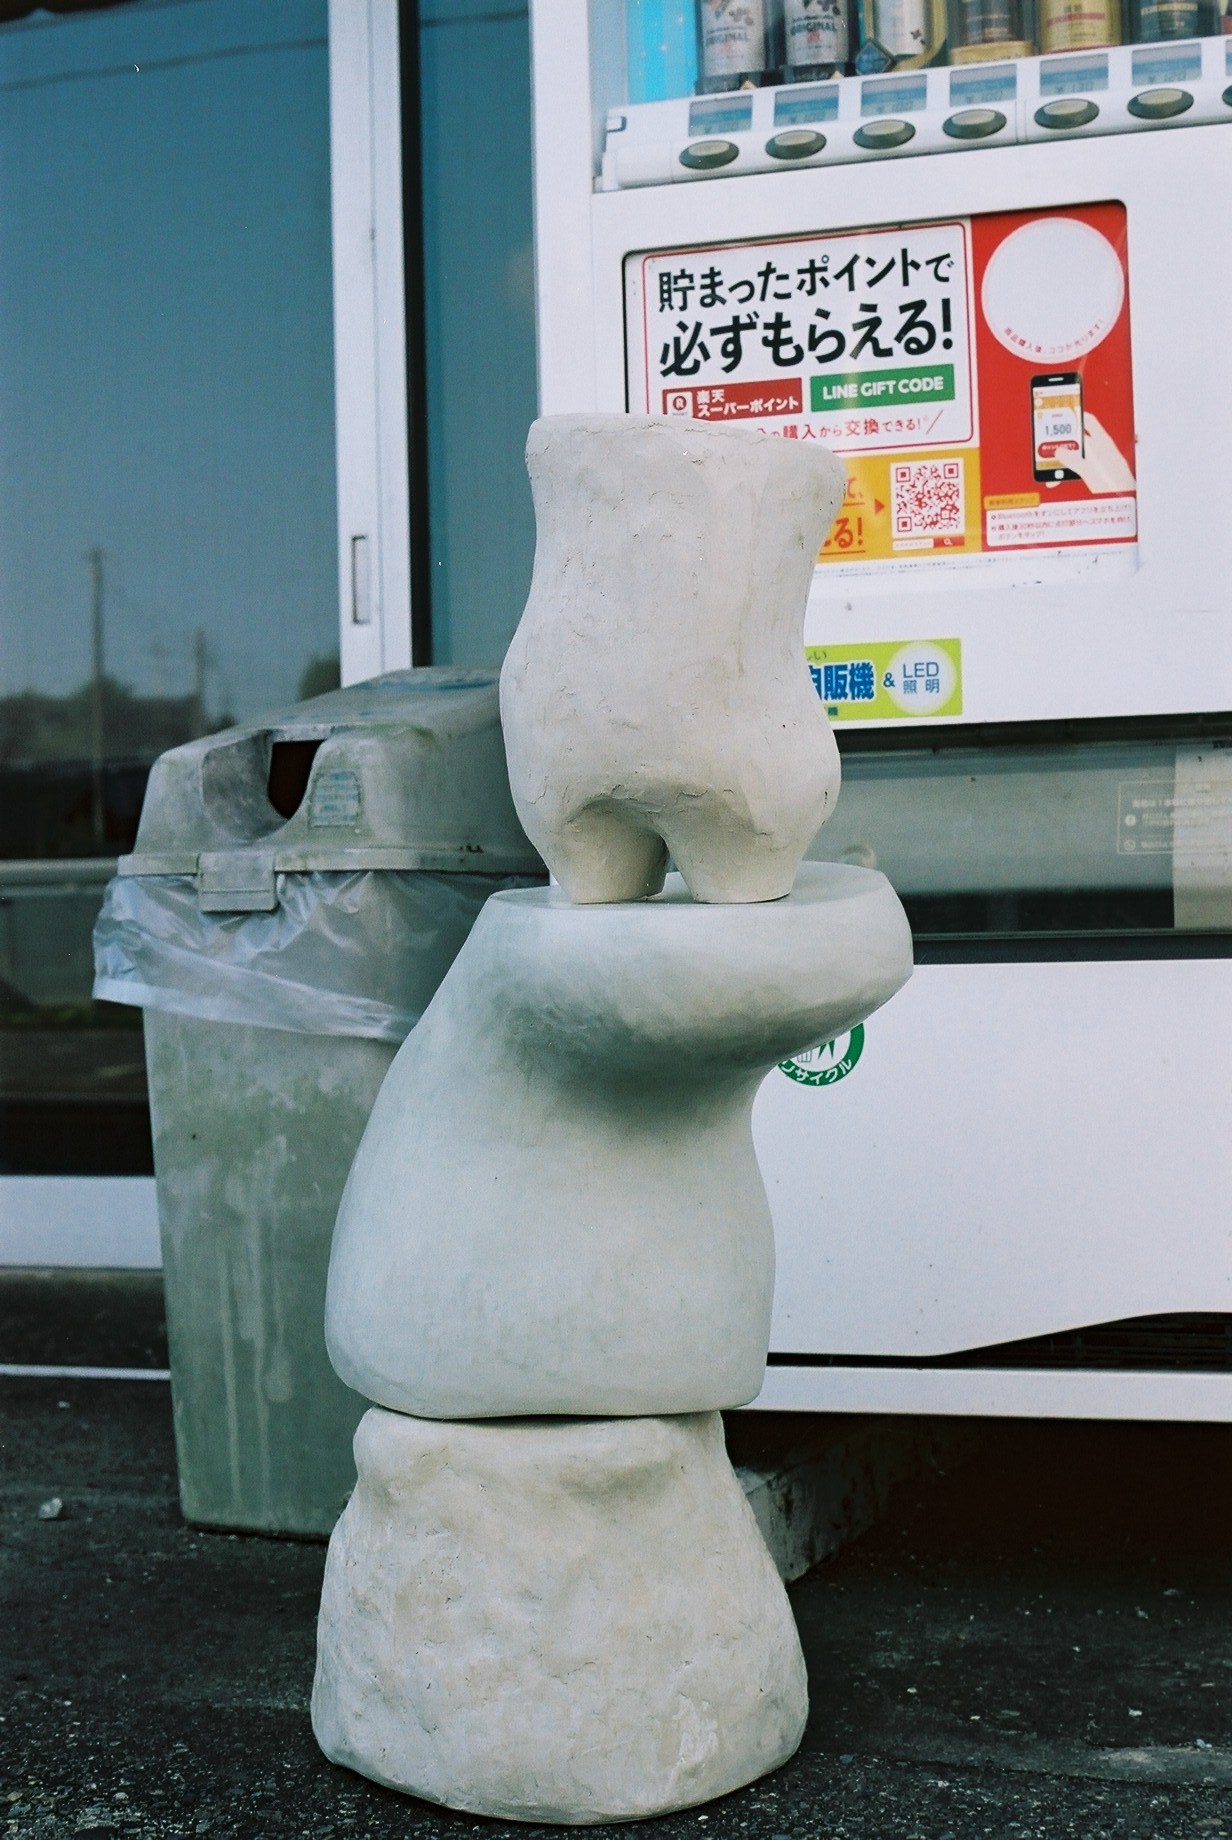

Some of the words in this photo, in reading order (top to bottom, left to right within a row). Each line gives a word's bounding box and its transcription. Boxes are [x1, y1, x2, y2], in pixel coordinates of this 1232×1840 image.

[659, 248, 954, 312] 貯まったポイントで
[659, 298, 953, 377] 必ずもらえる!
[696, 388, 725, 404] 楽天
[822, 384, 859, 400] LINE
[860, 380, 897, 397] GIFT
[898, 376, 944, 394] CODE
[697, 396, 799, 418] スーパーポイント
[1045, 424, 1072, 436] 1,500
[824, 517, 863, 548] る!
[903, 662, 940, 678] LED
[903, 678, 940, 695] 照明
